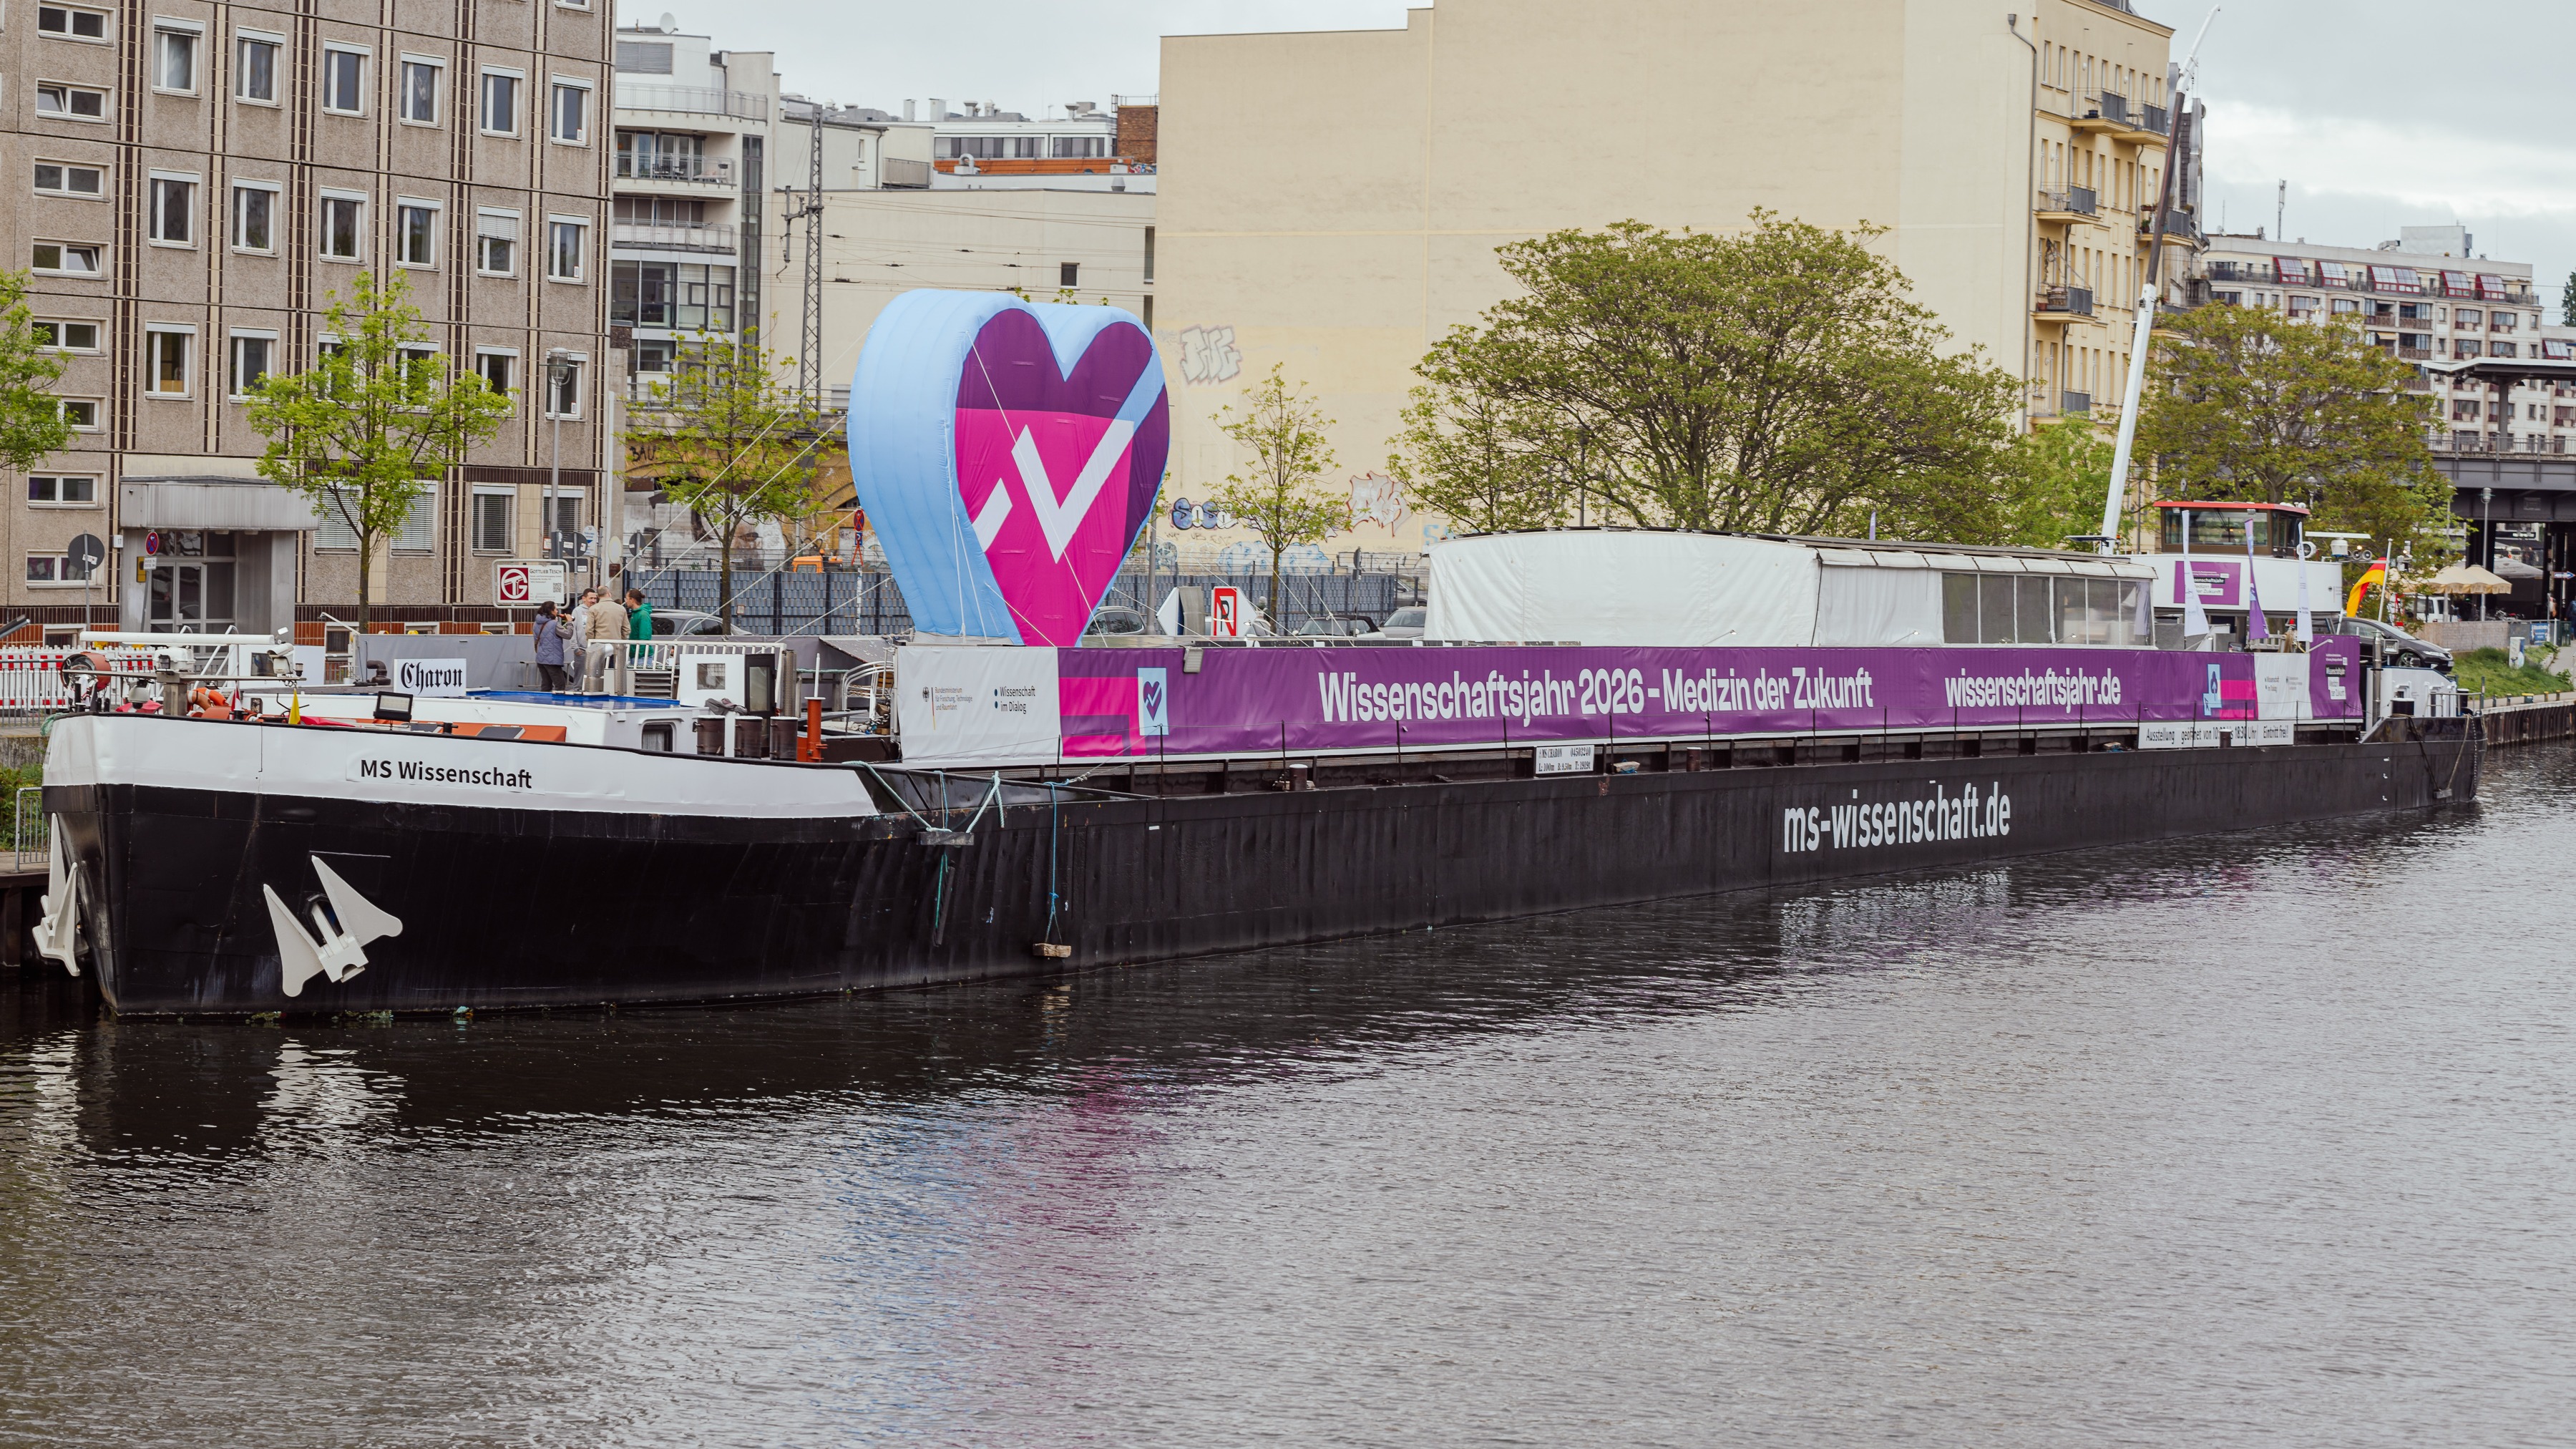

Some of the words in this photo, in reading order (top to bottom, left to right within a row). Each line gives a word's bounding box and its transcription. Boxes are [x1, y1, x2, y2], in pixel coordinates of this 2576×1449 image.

[401, 662, 463, 696] Charon
[1945, 667, 2121, 713] wissenschaftsjahr.de
[1000, 686, 1035, 697] Wissenschaft
[1318, 669, 1575, 727] Wissenschaftsjahr
[1579, 668, 1644, 715] 2026
[1662, 668, 1752, 713] Medizin
[1754, 668, 1790, 711] der
[1792, 667, 1873, 709] Zukunft
[1001, 701, 1008, 712] im
[1009, 701, 1027, 714] Dialog
[2146, 727, 2175, 744] Ausstellung
[2203, 730, 2212, 740] von
[2248, 726, 2256, 739] Uhr
[2263, 725, 2278, 738] Eintritt
[1548, 748, 1563, 758] CHARON
[361, 759, 392, 779] MS
[399, 761, 532, 789] Wissenschaft
[1784, 781, 2011, 852] ms-wissenschaft.de
